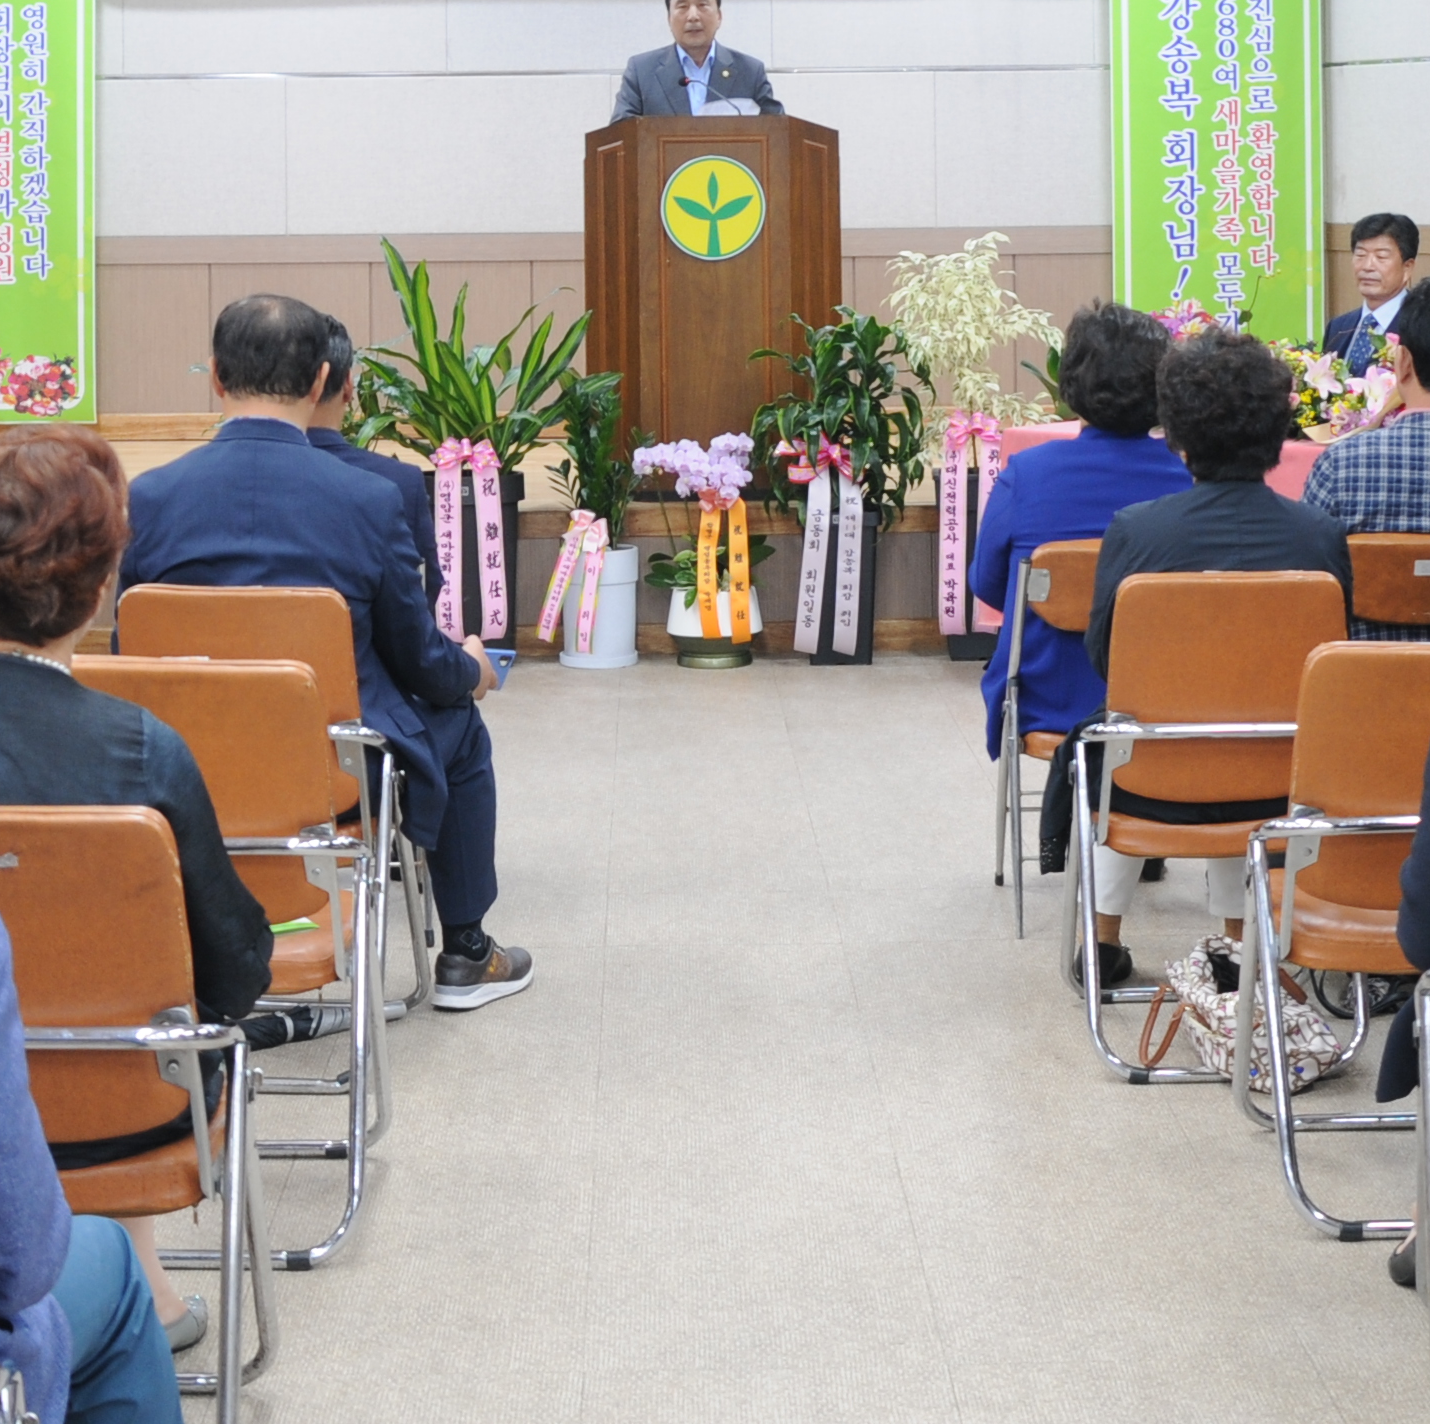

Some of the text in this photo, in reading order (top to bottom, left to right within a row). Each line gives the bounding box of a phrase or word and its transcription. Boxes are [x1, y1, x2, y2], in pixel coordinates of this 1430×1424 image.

[21, 4, 51, 278] 영원히 간직하겠습니다
[1163, 130, 1204, 299] 회장님!
[1213, 98, 1244, 244] 새마을가족
[1248, 122, 1278, 272] 환영합니다
[945, 552, 956, 571] 대표
